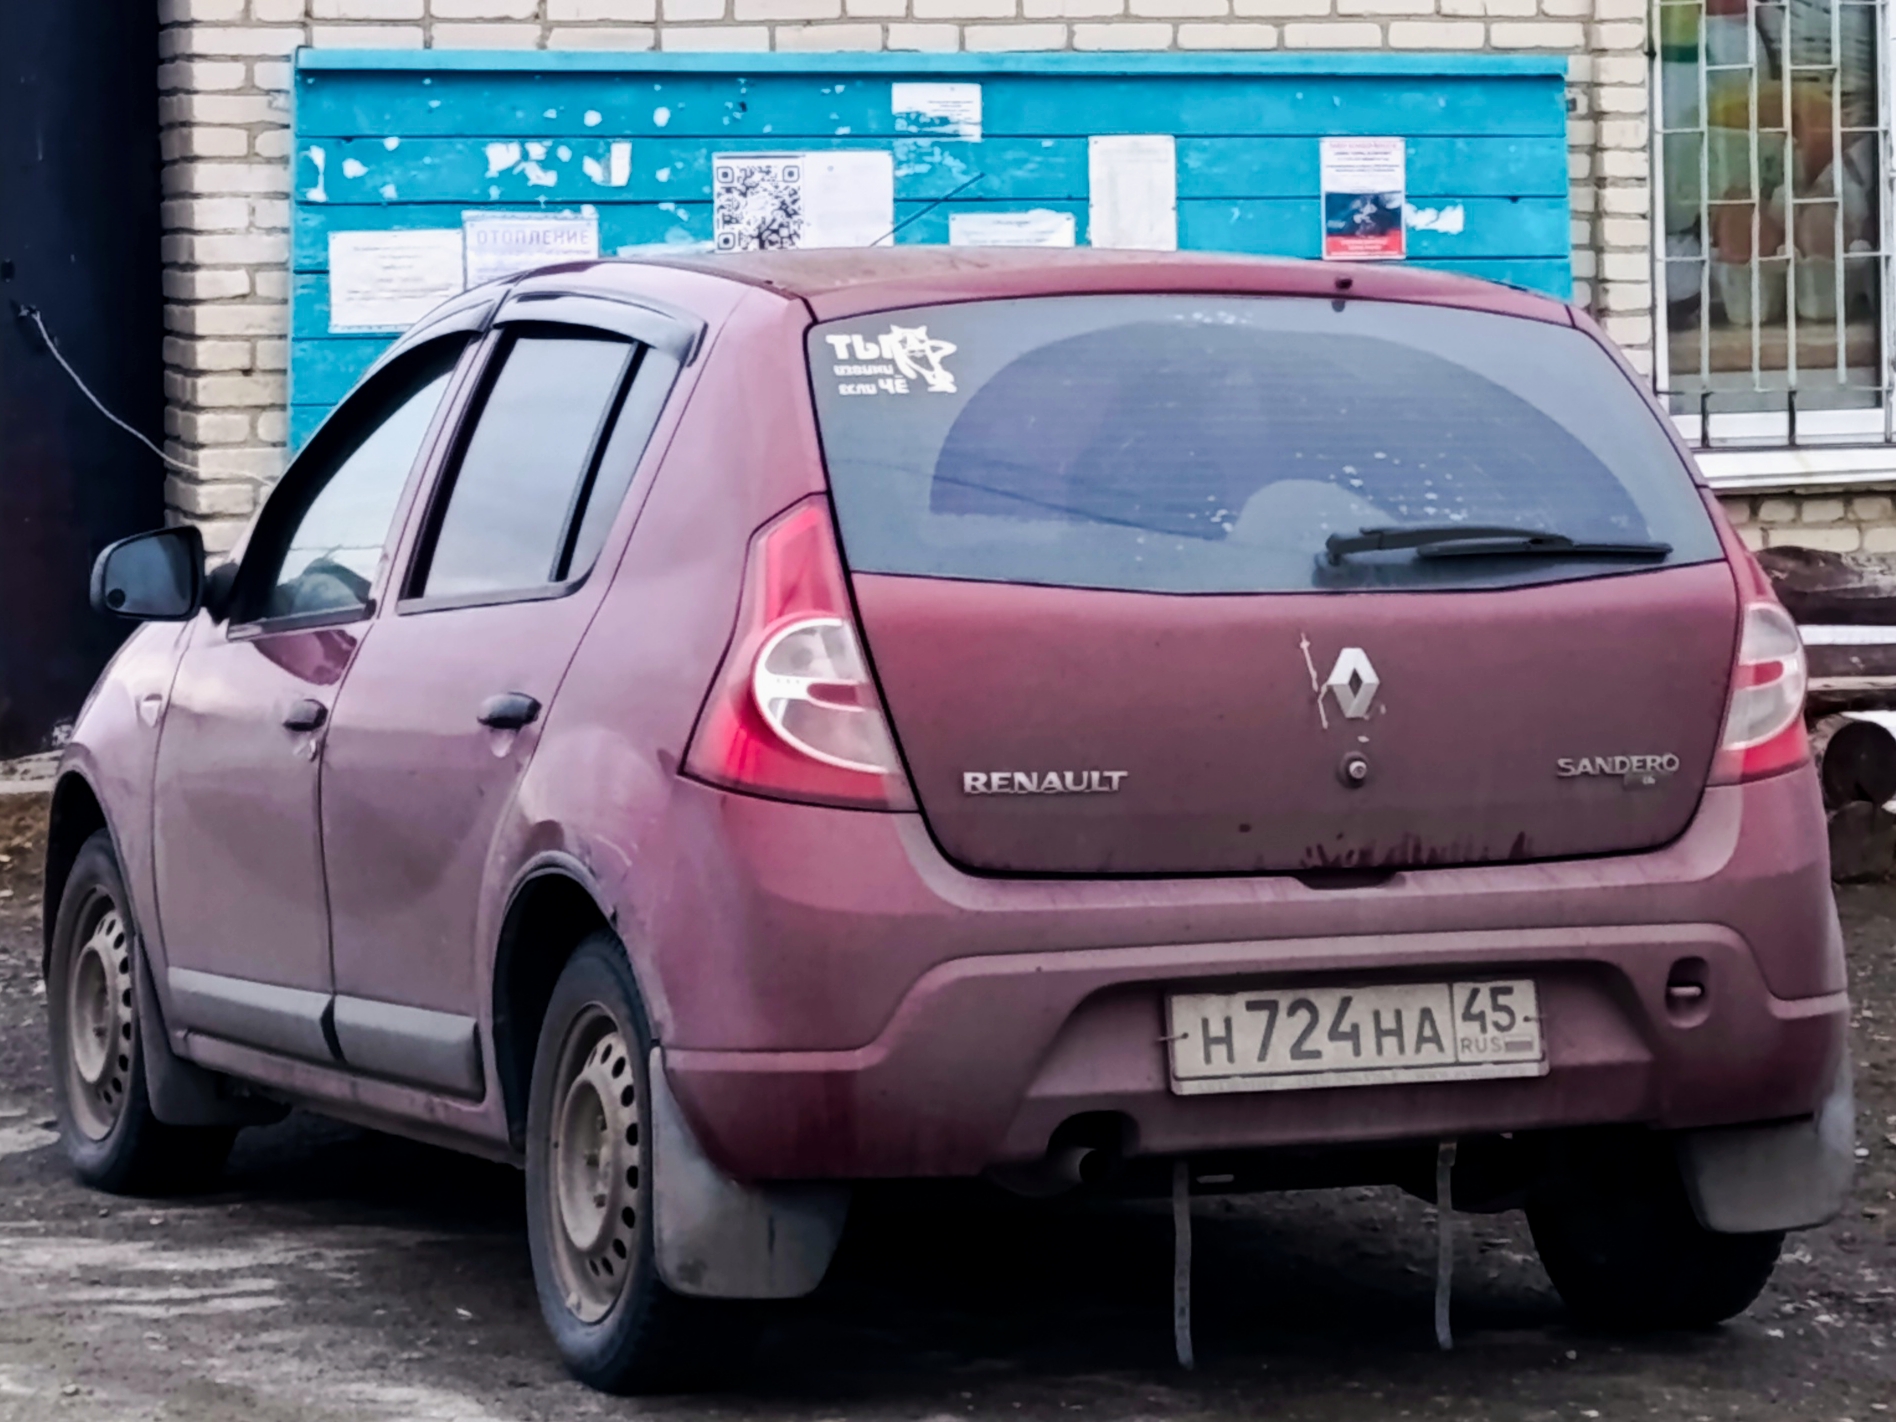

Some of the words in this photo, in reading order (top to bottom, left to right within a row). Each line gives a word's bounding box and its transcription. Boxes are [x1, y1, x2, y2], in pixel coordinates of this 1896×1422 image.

[476, 229, 590, 246] ОТОПЛЕНИЕ
[1556, 753, 1680, 777] SANDERO
[963, 770, 1129, 794] RENAULT
[1461, 986, 1516, 1035] 45
[1460, 1035, 1504, 1054] RUS
